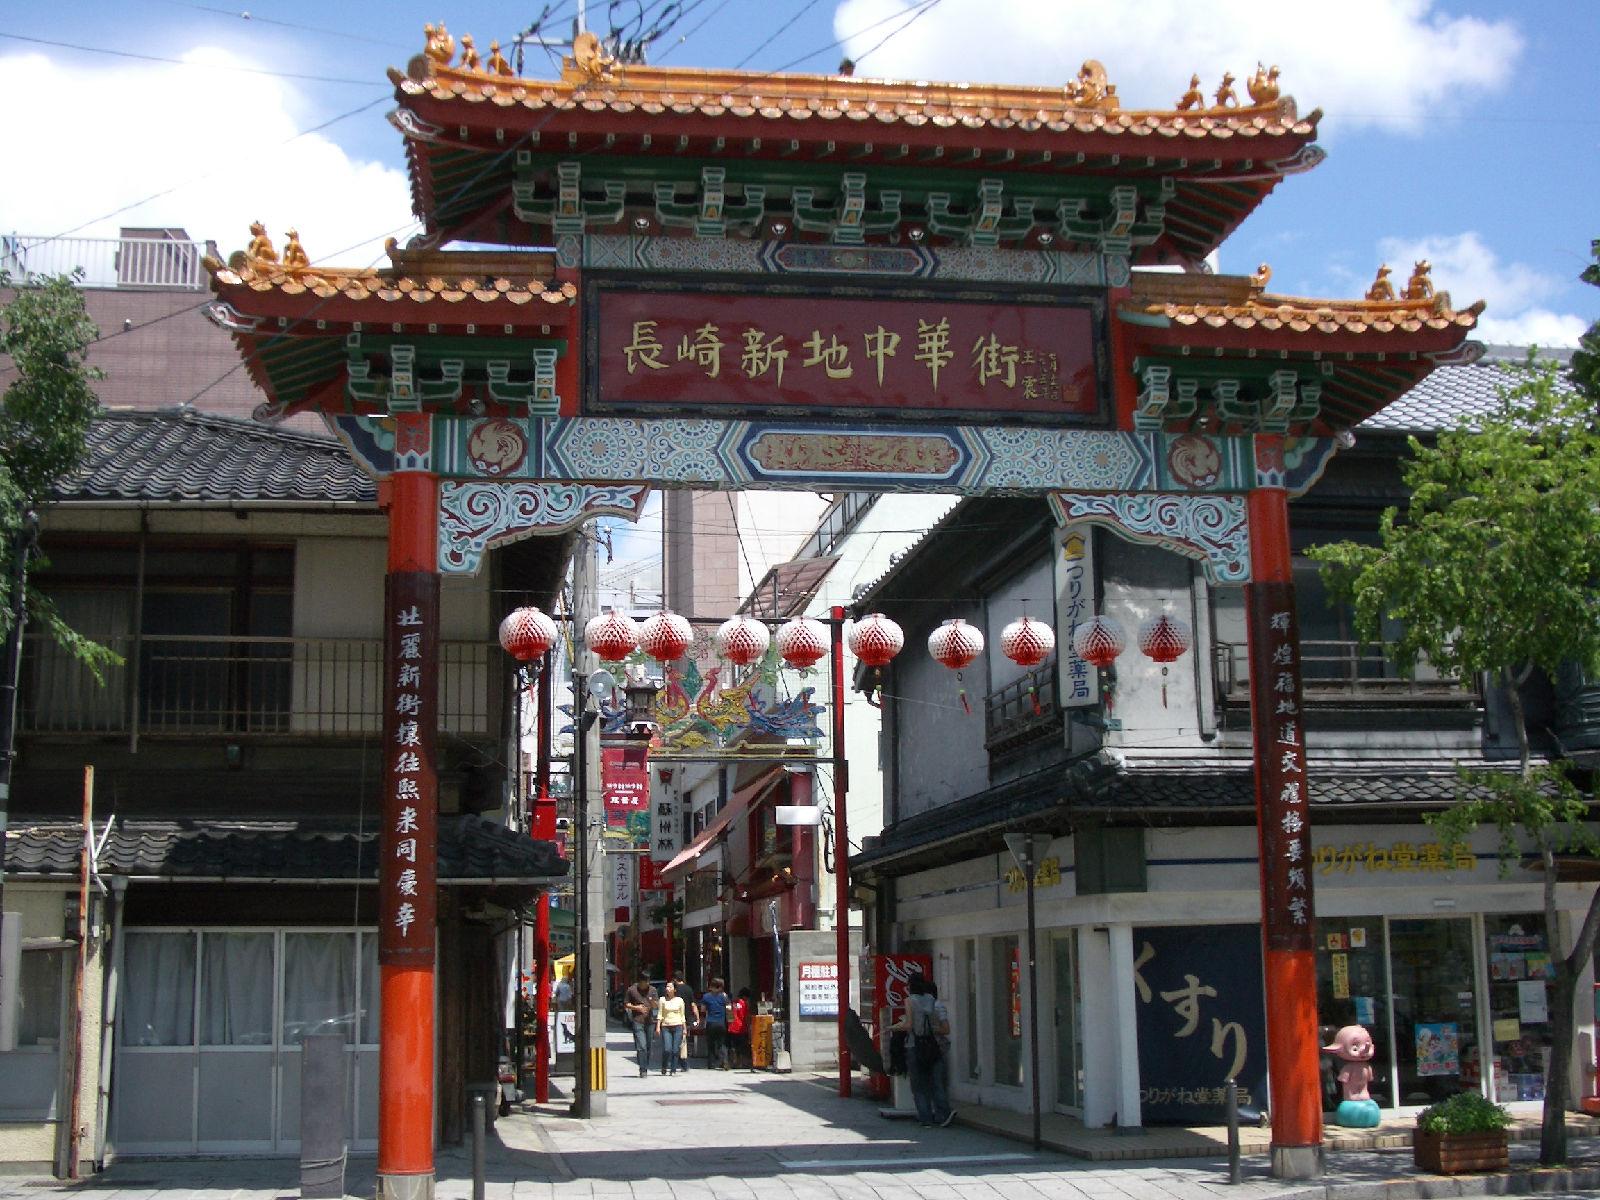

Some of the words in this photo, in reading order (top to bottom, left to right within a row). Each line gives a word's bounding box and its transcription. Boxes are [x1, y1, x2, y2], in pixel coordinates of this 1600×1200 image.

[623, 317, 1019, 393] 長崎新地中華街
[1134, 941, 1248, 1082] くすり
